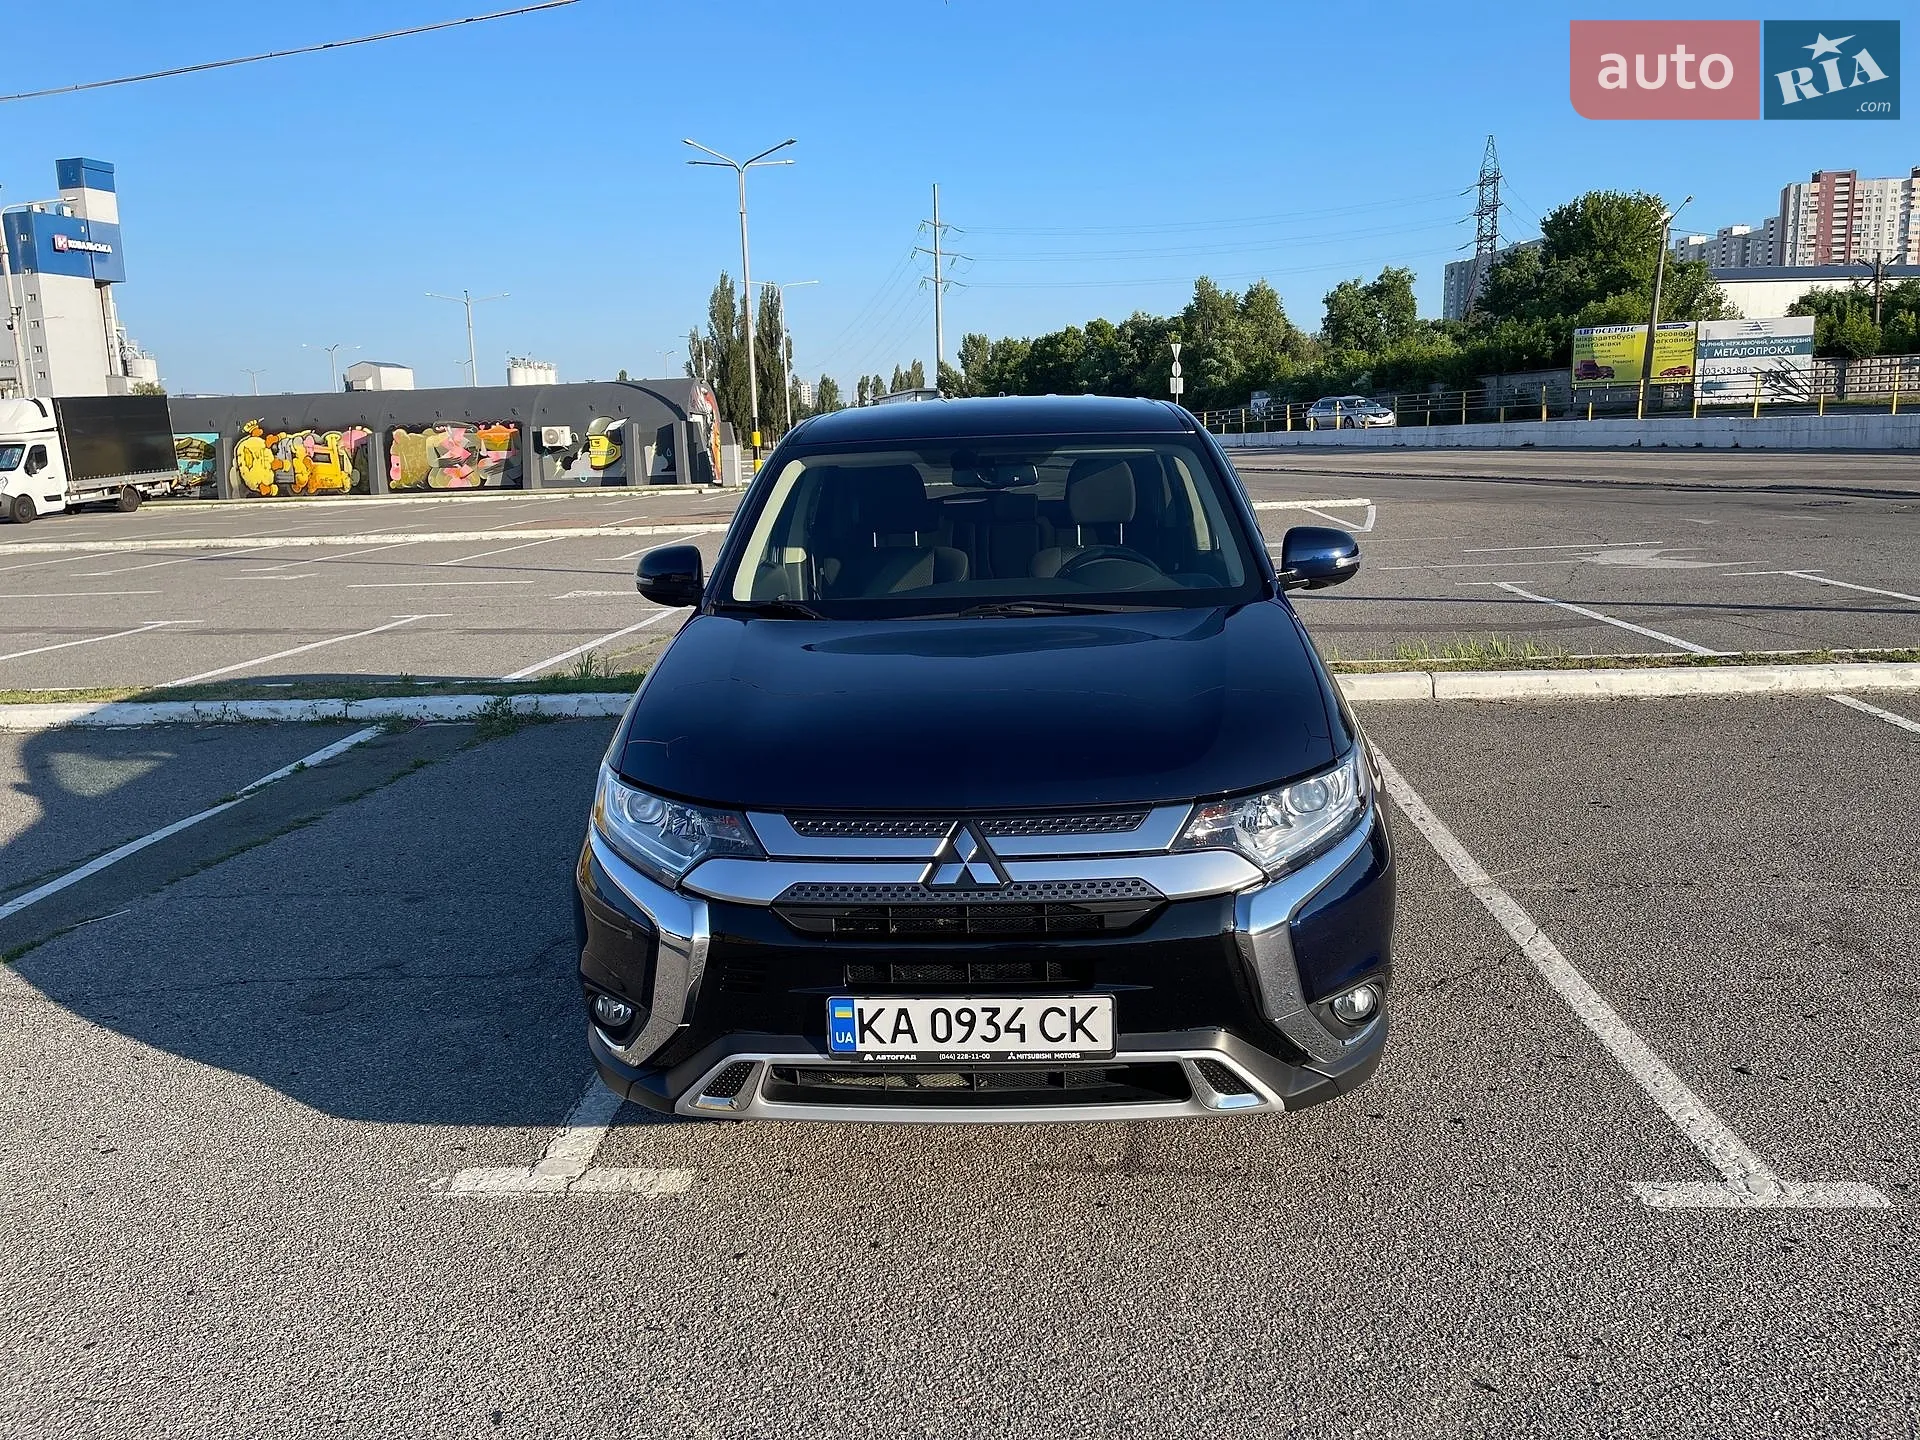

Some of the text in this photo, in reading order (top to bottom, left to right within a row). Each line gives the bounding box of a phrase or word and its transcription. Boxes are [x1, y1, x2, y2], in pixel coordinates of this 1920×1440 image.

[1576, 326, 1637, 335] АВТОСЕРВІС
[1713, 346, 1796, 357] МЕТАЛОПРОКАТ
[858, 1006, 1099, 1044] KA 0934 CK
[836, 1032, 854, 1044] UA
